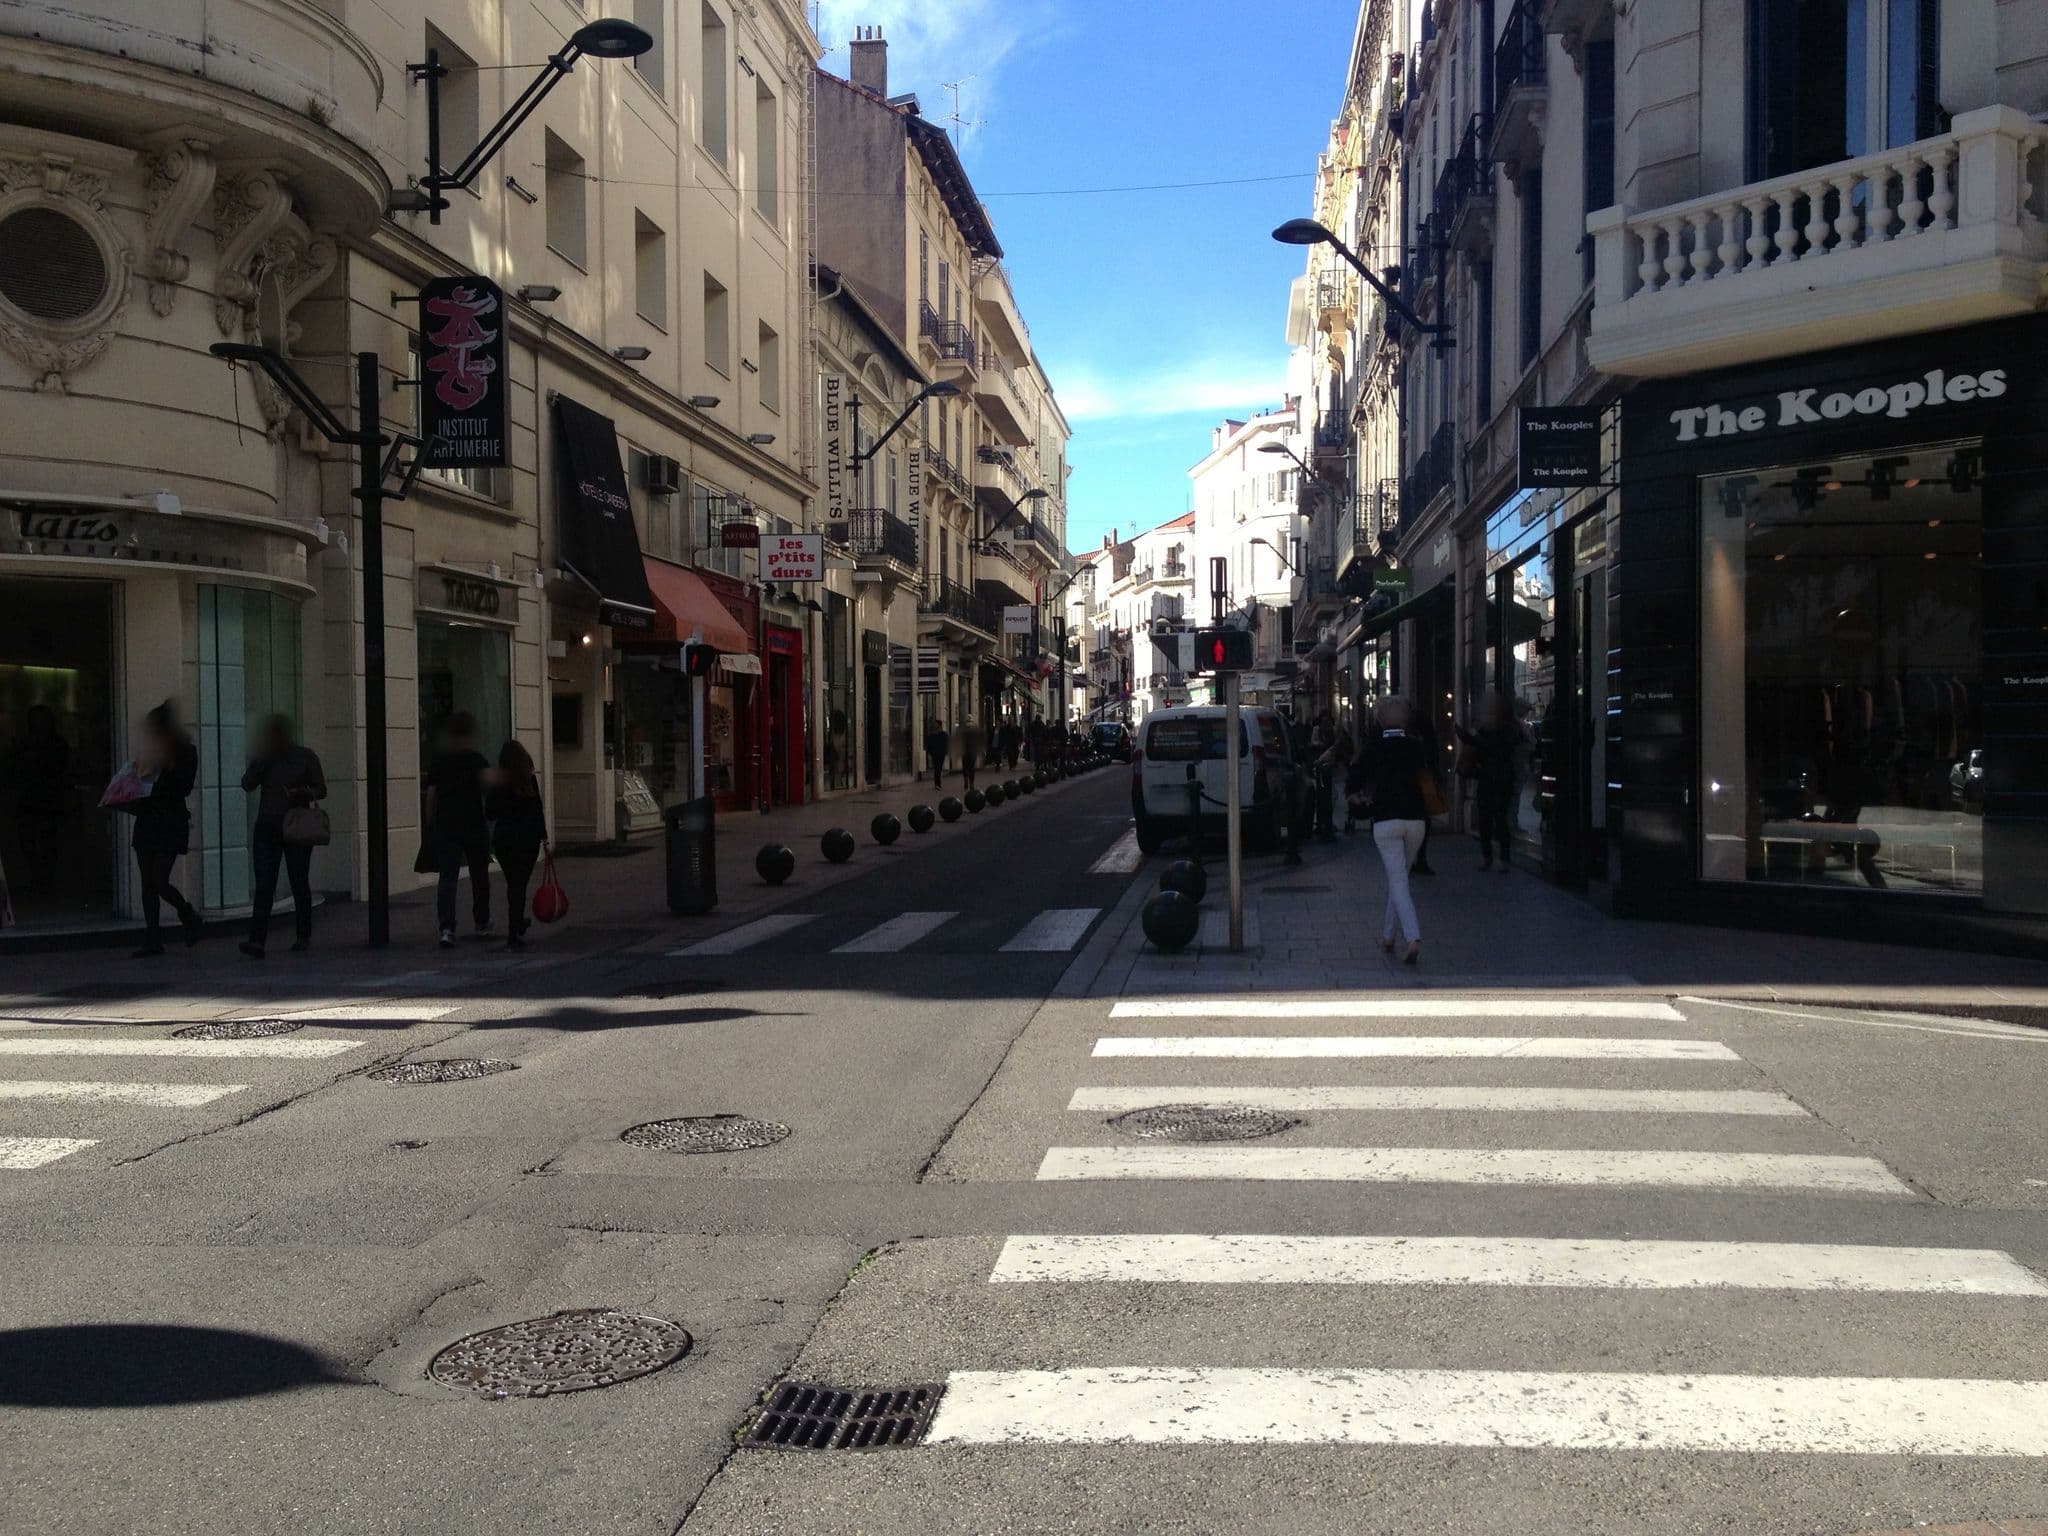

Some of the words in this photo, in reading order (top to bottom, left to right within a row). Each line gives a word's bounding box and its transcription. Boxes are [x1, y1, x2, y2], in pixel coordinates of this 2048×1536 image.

[827, 377, 840, 432] BLUE
[1669, 403, 1767, 441] The
[1776, 368, 2008, 426] Kooples
[438, 418, 489, 437] INSTITUT
[1526, 421, 1548, 431] The
[1551, 420, 1594, 431] Kooples
[433, 439, 501, 458] ARFUMERIE
[828, 437, 842, 519] WILLI'S
[909, 451, 920, 497] BLUE
[1532, 467, 1551, 477] The
[1552, 466, 1589, 477] Kooples
[779, 538, 804, 550] les
[767, 551, 816, 565] p'tits
[771, 567, 814, 578] durs
[2002, 676, 2021, 685] The
